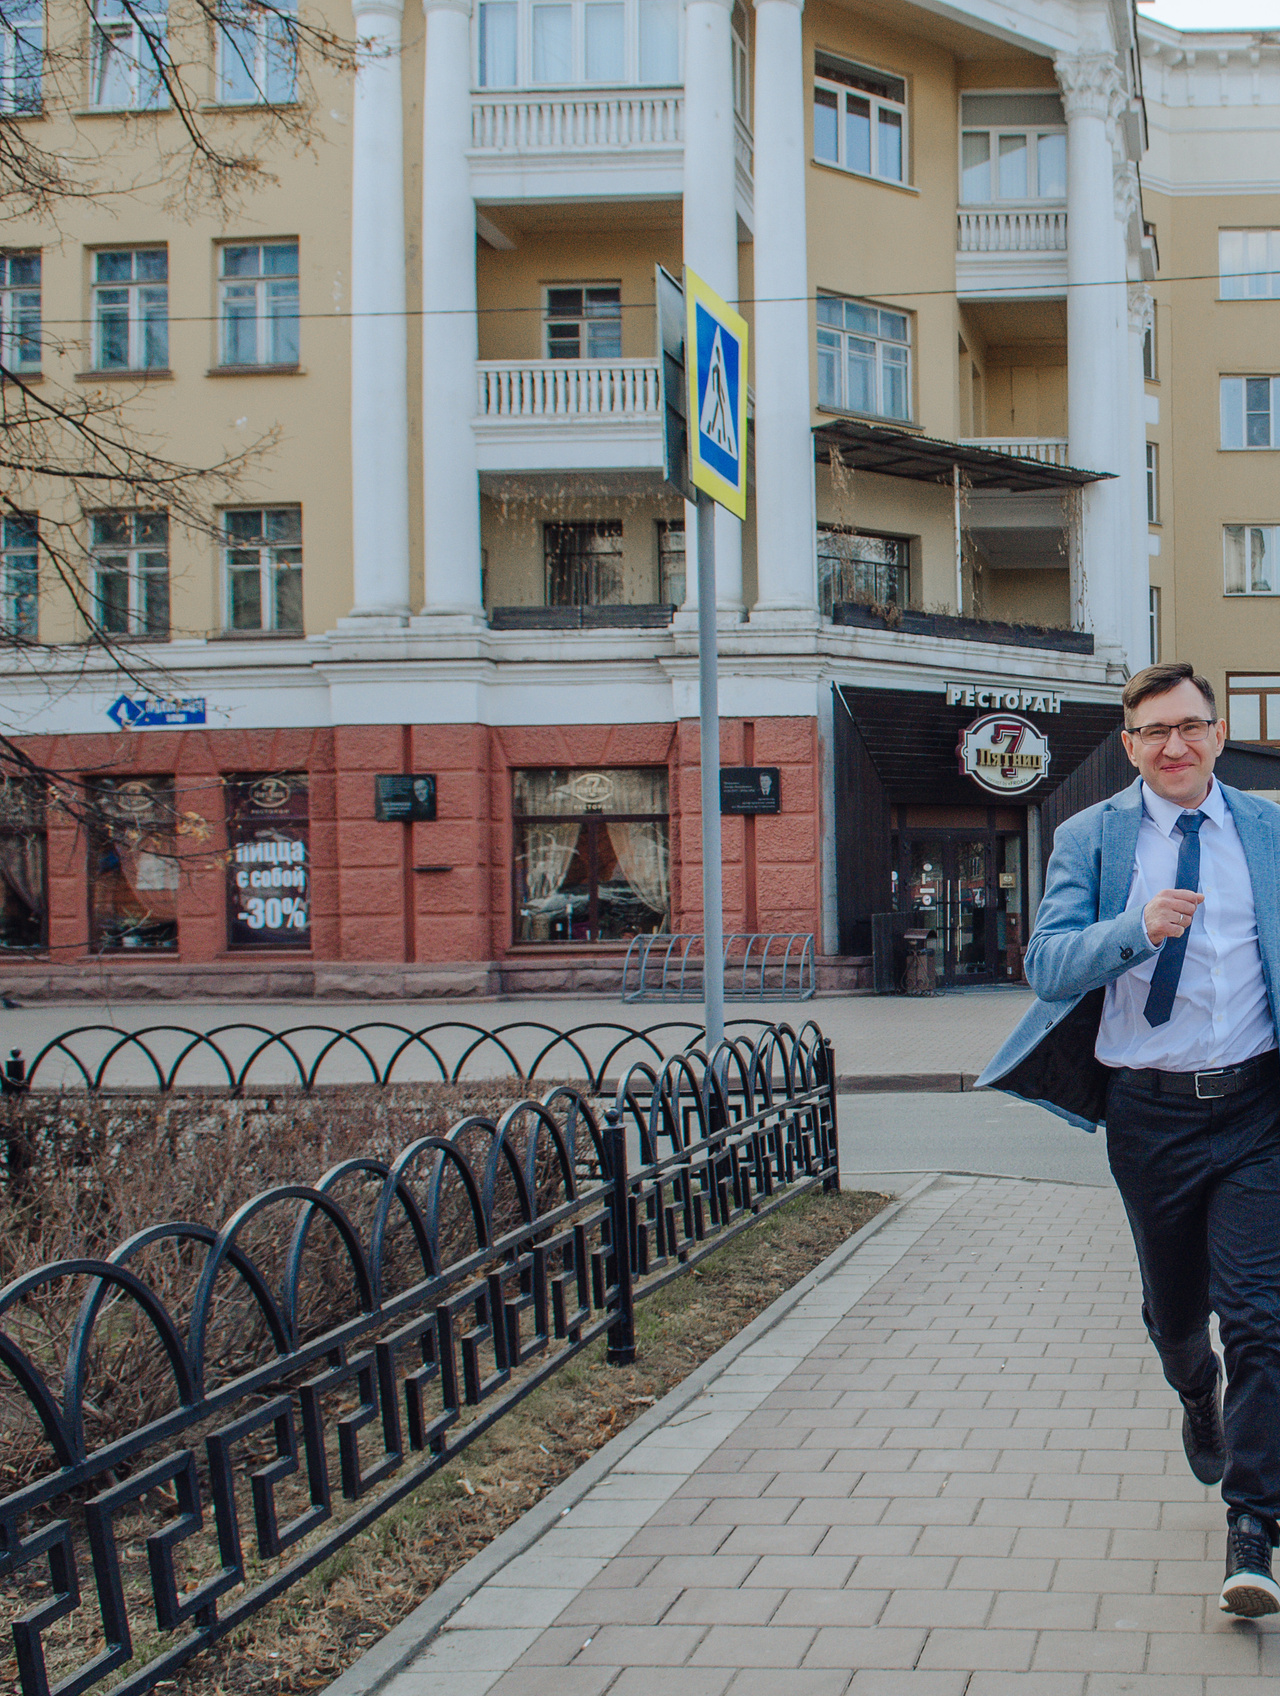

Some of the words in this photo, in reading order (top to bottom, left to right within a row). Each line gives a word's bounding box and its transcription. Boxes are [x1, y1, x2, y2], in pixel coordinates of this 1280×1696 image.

[945, 688, 1061, 713] РЕСТОРАН
[976, 748, 1043, 770] Пятниц
[991, 723, 1026, 778] 7
[236, 841, 305, 865] пицца
[236, 871, 249, 889] с
[250, 866, 306, 888] собой
[237, 897, 306, 929] -30%
